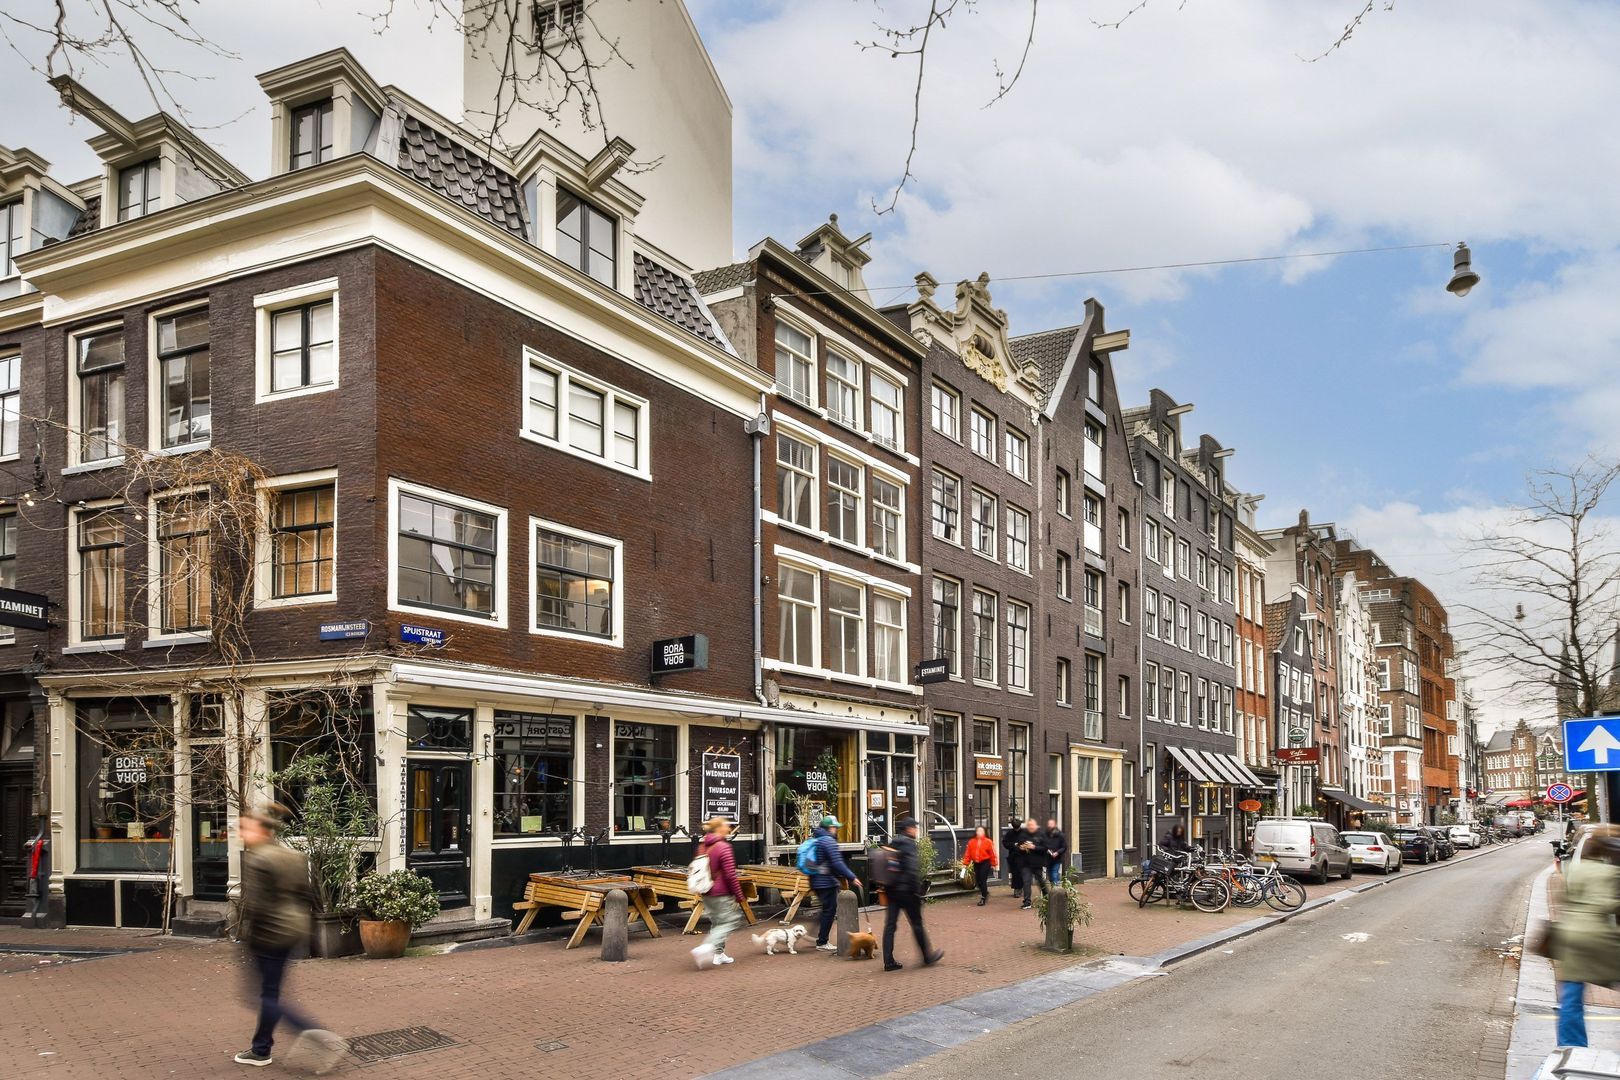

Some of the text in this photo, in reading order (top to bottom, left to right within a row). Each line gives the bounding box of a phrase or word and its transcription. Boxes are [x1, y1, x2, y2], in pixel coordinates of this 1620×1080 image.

[403, 626, 442, 639] SPUISTRAAT
[664, 643, 684, 654] BORA
[664, 655, 684, 665] BORA
[115, 757, 146, 769] BORA
[116, 772, 147, 783] BORA
[806, 771, 827, 780] BORA
[807, 782, 828, 791] BORA
